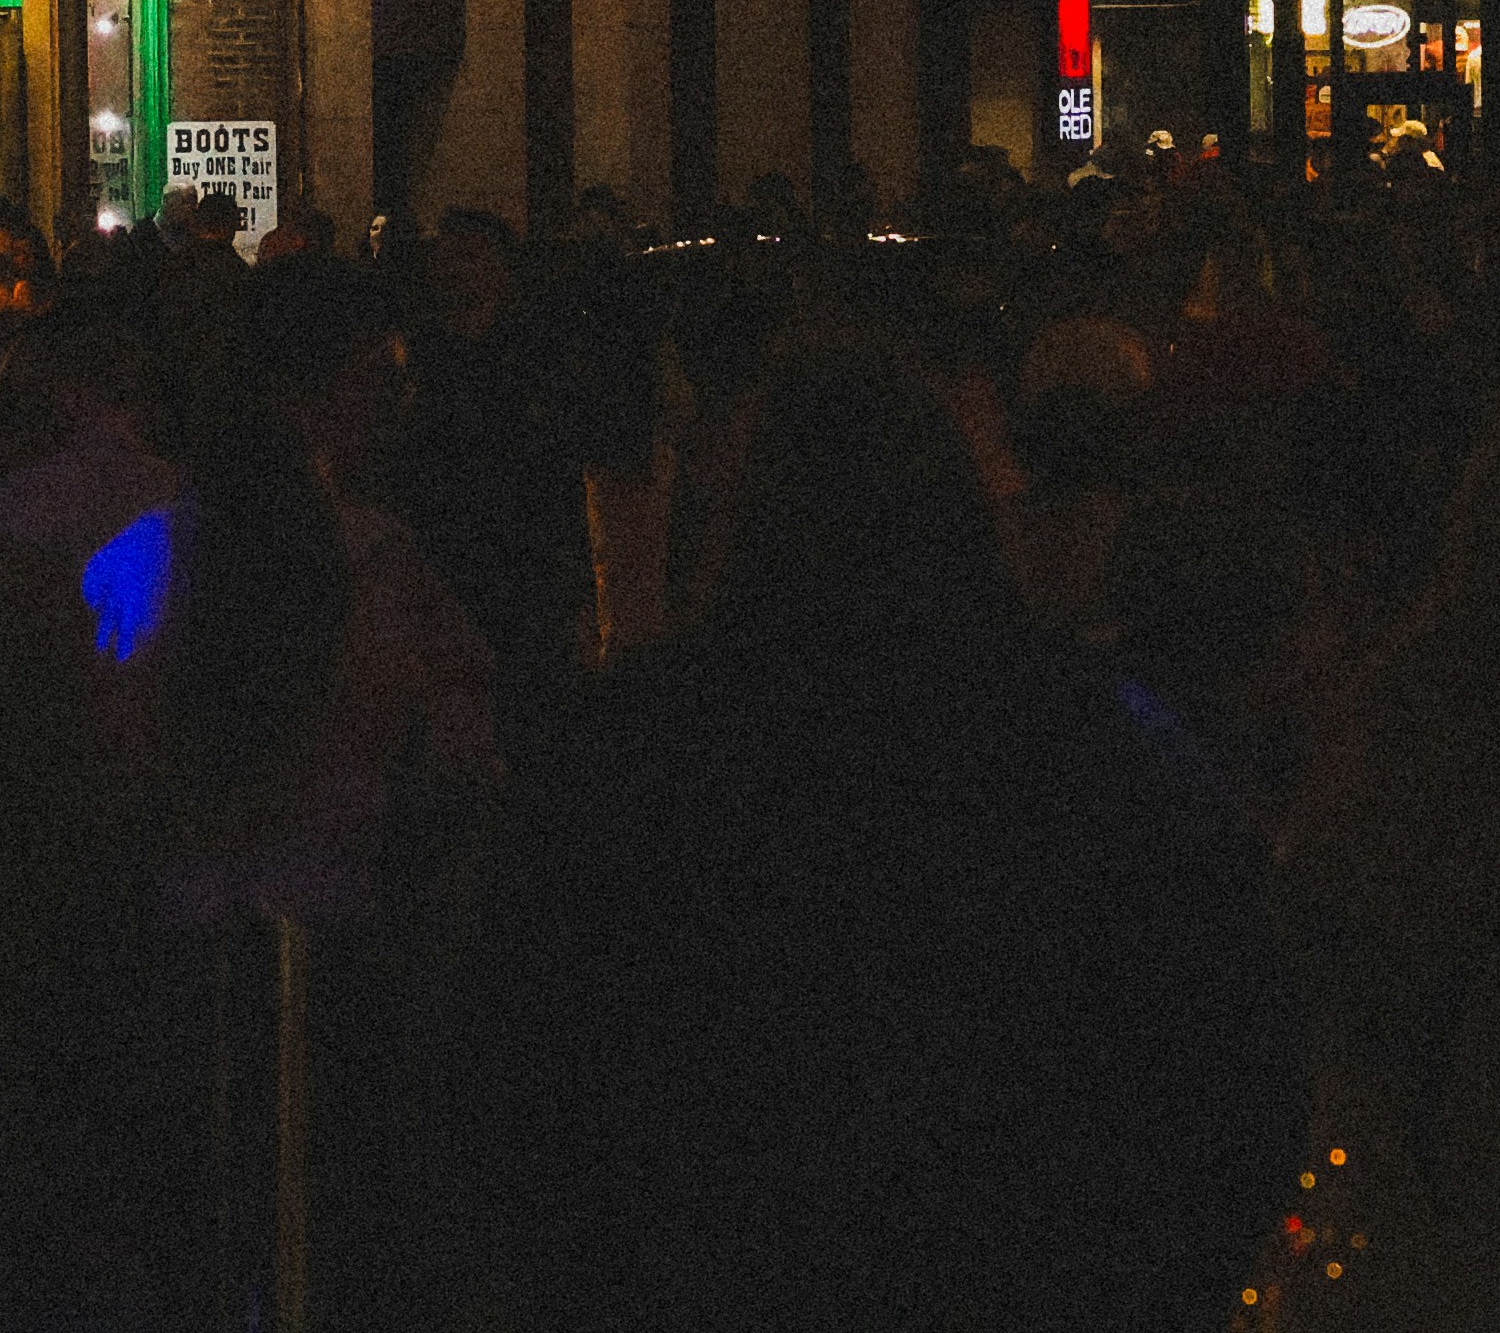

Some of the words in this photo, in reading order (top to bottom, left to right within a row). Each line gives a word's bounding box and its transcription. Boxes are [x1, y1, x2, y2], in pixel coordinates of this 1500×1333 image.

[1058, 88, 1092, 114] OLE
[175, 123, 270, 154] BOOTS
[1059, 114, 1092, 141] RED
[172, 157, 200, 181] Buy
[206, 158, 237, 176] ONE
[242, 156, 273, 176] Pair
[243, 181, 274, 201] Pair
